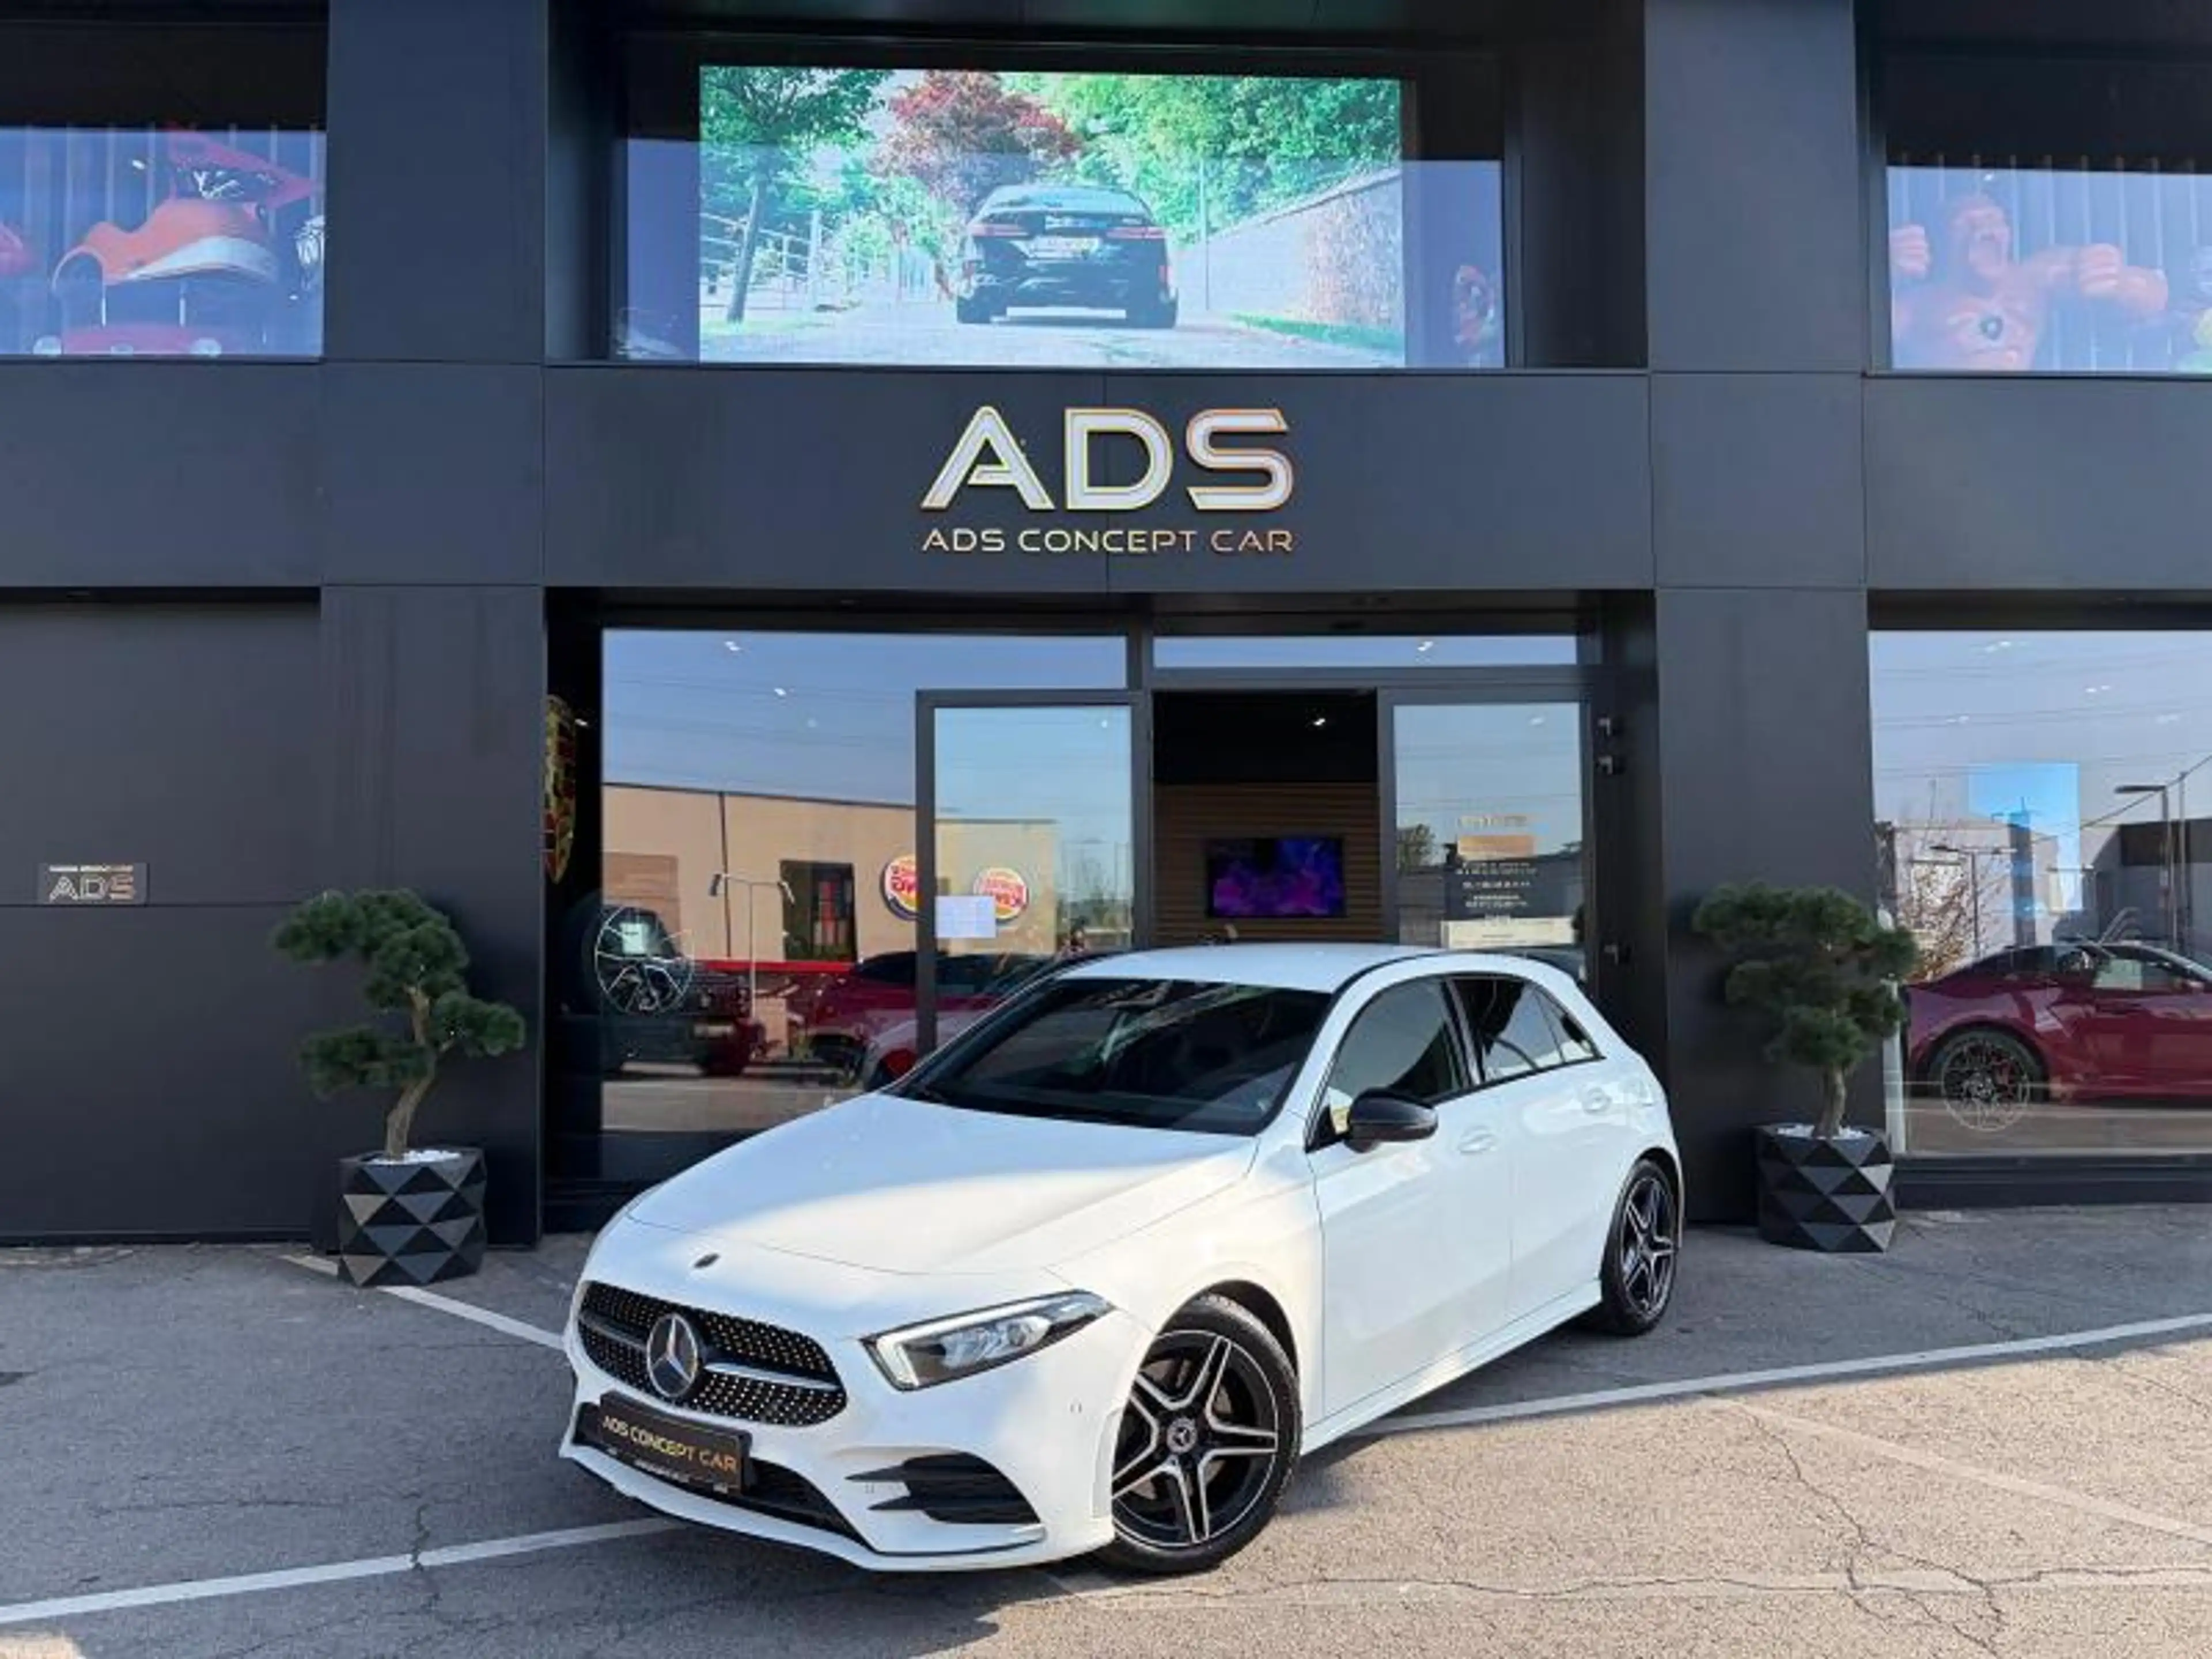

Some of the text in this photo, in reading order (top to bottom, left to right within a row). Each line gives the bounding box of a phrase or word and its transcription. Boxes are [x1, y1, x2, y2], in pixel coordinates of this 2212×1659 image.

[921, 406, 1294, 510] ADS
[922, 528, 1294, 553] ADS CONCEPT CAR
[49, 874, 137, 900] ADS
[602, 1415, 628, 1437] ADS
[630, 1426, 696, 1461] CONCEPT
[699, 1450, 737, 1472] CAR
